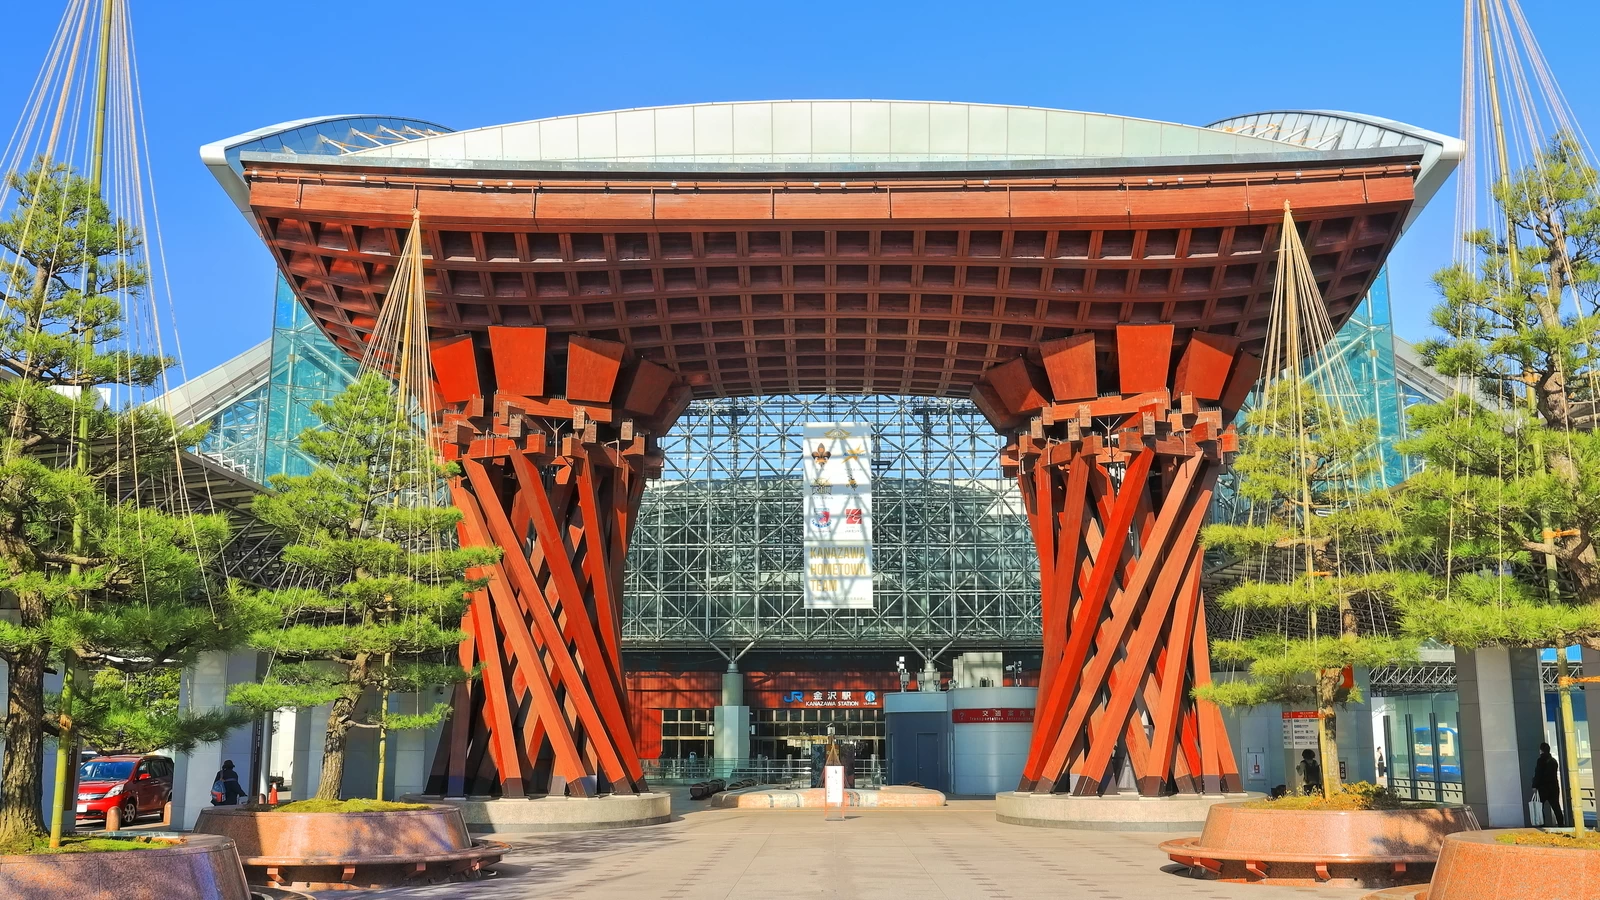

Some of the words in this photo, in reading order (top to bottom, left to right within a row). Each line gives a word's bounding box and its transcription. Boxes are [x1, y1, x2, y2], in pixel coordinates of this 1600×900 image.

[810, 547, 865, 559] KANAZAWA
[810, 563, 866, 576] HOMETOWN
[810, 579, 837, 592] TEAM
[783, 691, 804, 703] JR
[813, 691, 851, 700] 金沢駅
